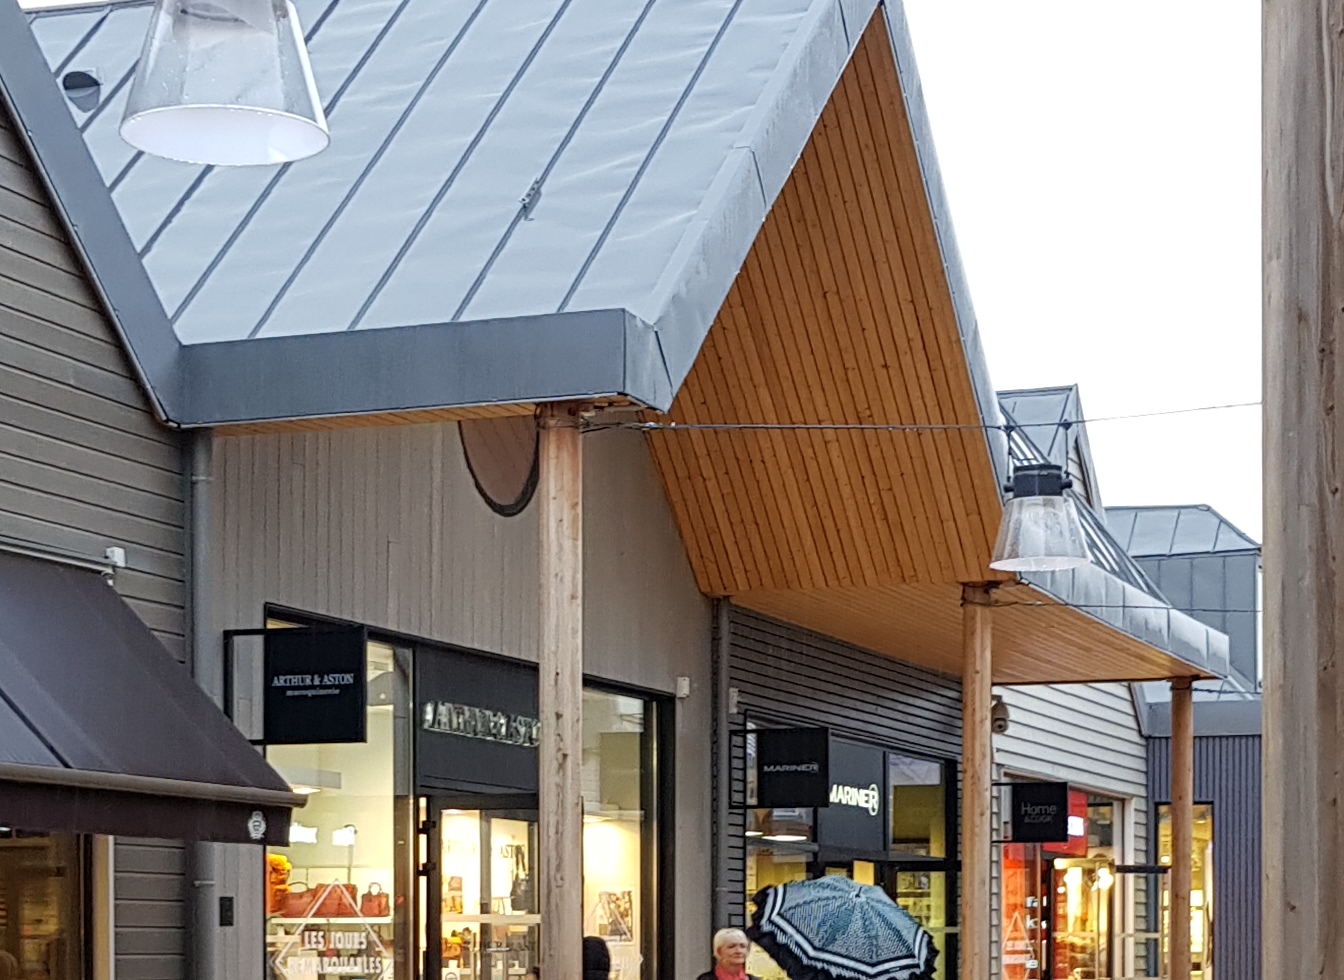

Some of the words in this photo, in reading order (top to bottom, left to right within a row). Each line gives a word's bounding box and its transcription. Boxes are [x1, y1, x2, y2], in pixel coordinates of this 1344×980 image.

[271, 674, 312, 687] ARTHUR
[313, 674, 321, 685] &
[322, 673, 354, 685] ASTON
[763, 761, 819, 774] MARINER
[1020, 801, 1057, 815] Home
[304, 930, 326, 949] LES
